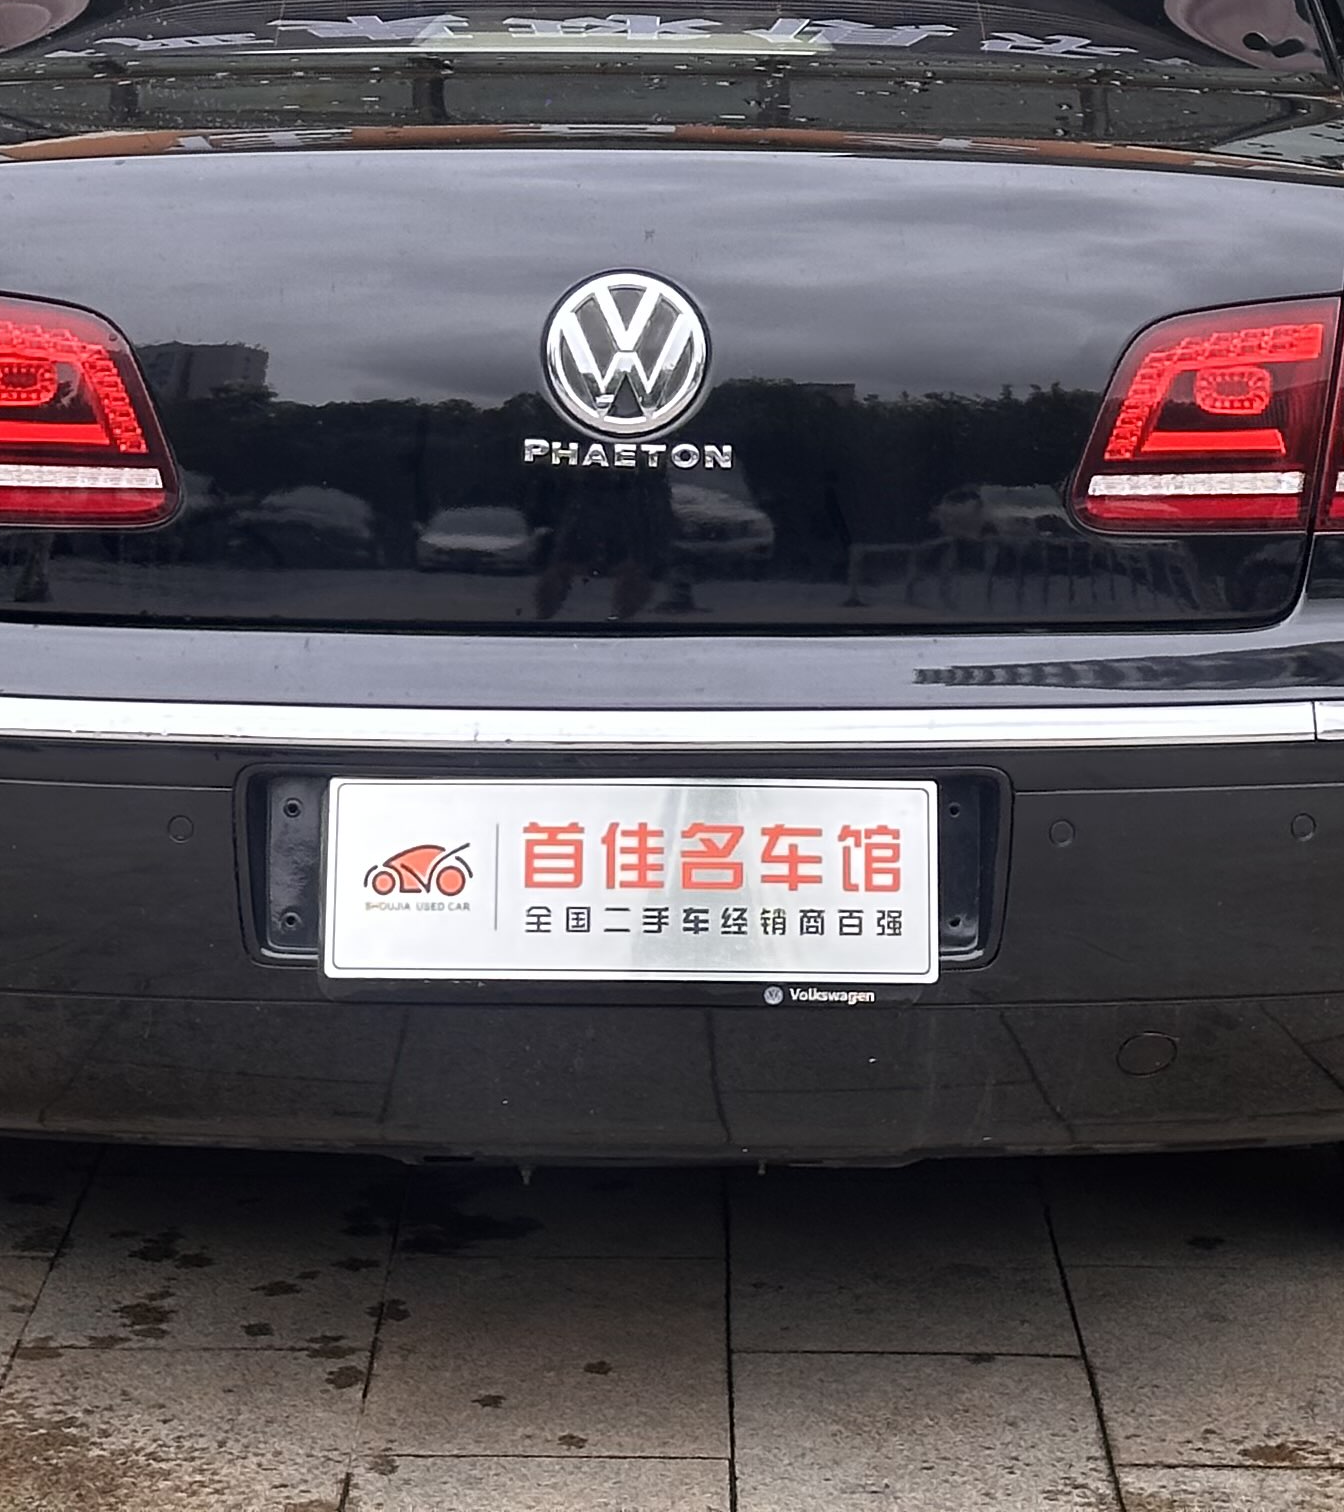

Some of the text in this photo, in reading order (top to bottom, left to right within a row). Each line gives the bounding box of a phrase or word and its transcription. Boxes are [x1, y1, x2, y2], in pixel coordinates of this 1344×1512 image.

[523, 438, 734, 469] PHAETON
[522, 822, 902, 893] 首佳名车馆
[415, 901, 445, 912] USED
[447, 901, 471, 912] CAR
[524, 906, 903, 937] 全国二手车经销商百强
[788, 987, 875, 1005] Volkswagen
